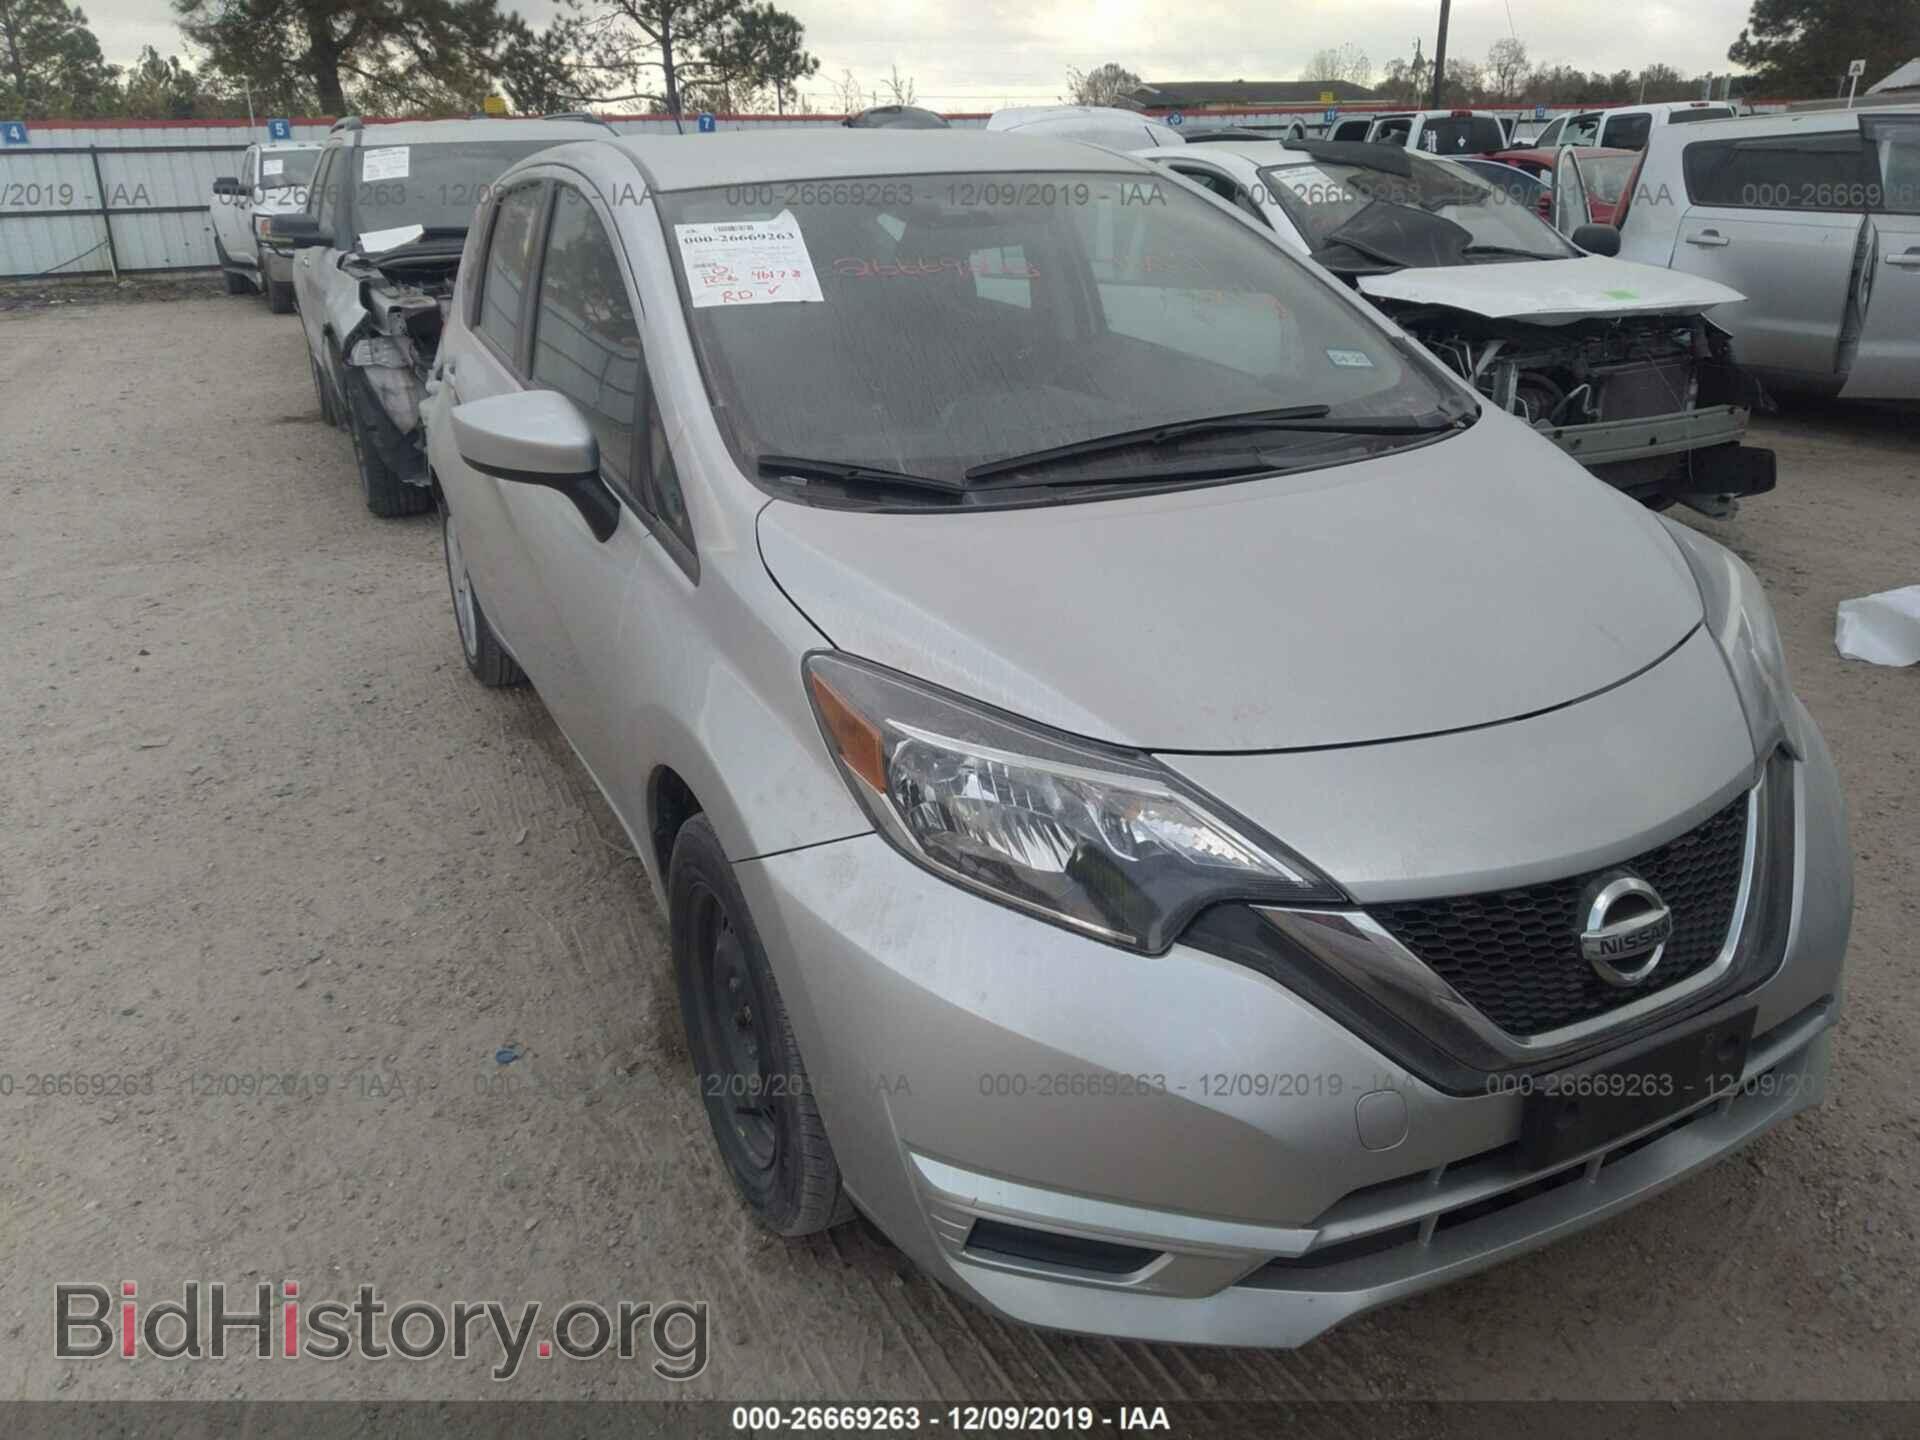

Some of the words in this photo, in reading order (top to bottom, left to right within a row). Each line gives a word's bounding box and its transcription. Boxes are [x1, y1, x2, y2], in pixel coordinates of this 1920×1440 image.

[9, 125, 20, 140] 4
[275, 122, 285, 137] 5
[684, 232, 795, 244] 000-26669263
[721, 290, 753, 303] RD
[1600, 919, 1670, 955] NISSAN
